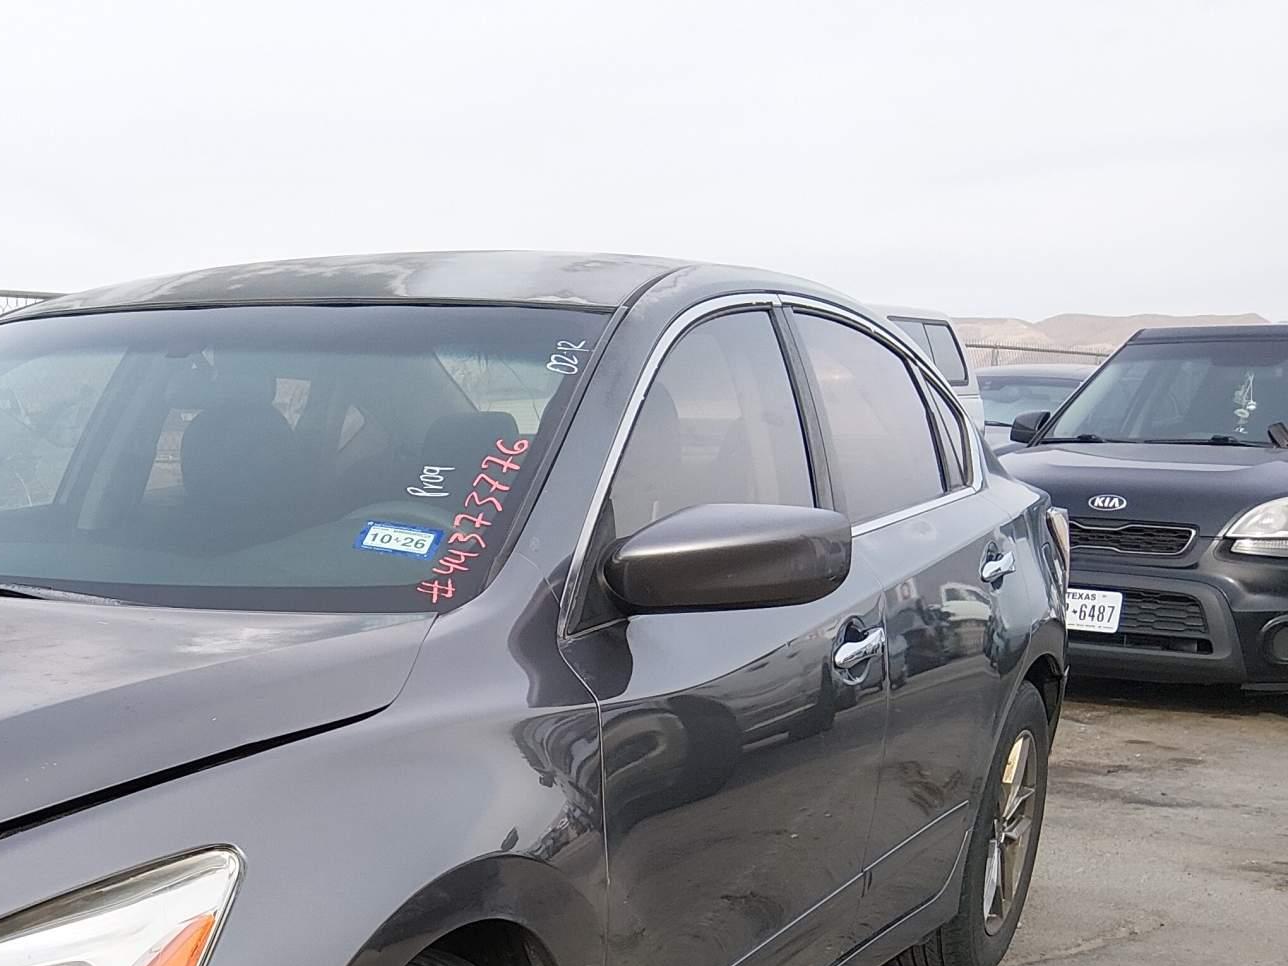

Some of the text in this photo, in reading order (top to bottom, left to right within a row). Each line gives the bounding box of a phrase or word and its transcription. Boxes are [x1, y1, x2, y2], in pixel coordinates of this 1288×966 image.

[1094, 497, 1119, 507] KIA
[417, 439, 529, 602] #44373776
[1066, 592, 1097, 600] TEXAS
